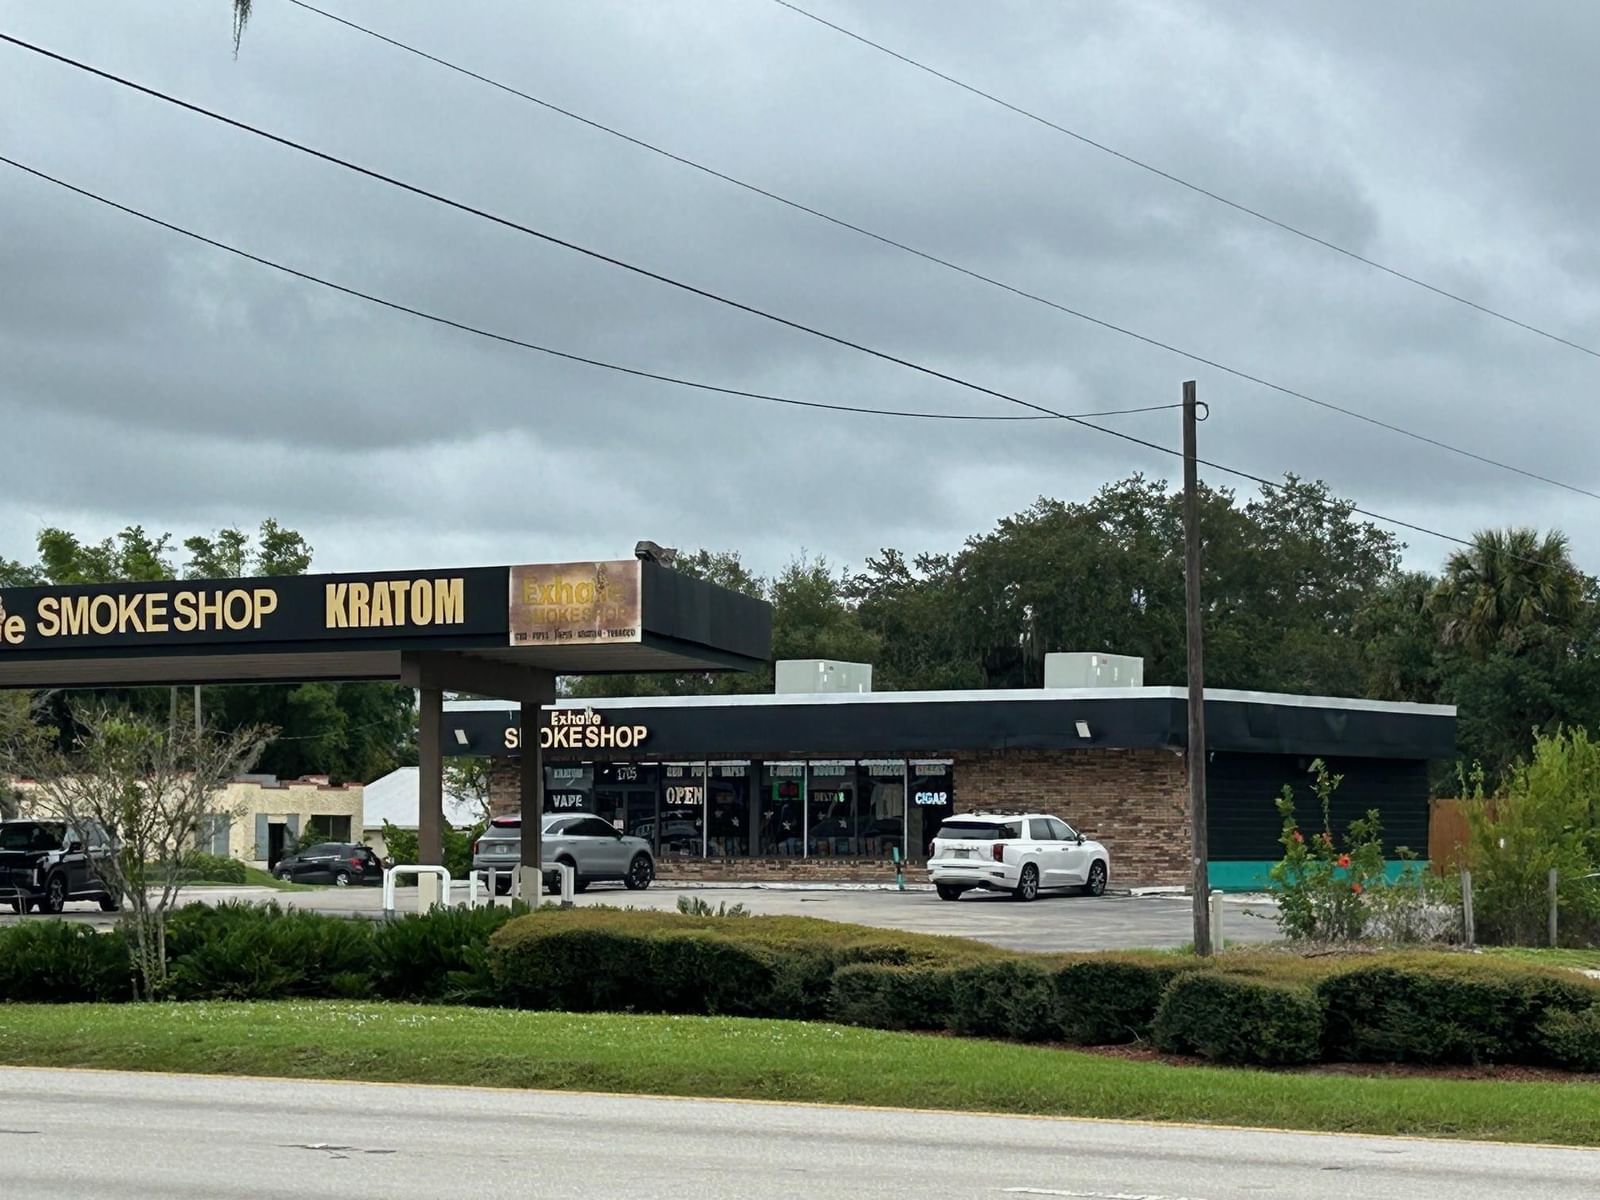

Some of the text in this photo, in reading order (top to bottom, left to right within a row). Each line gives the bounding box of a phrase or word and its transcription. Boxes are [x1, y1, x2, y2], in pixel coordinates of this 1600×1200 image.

[325, 577, 465, 629] KRATOM
[504, 724, 648, 749] SOKESHOP
[552, 794, 583, 808] VAPE
[666, 786, 703, 805] OPEN
[915, 791, 948, 805] CIGAR
